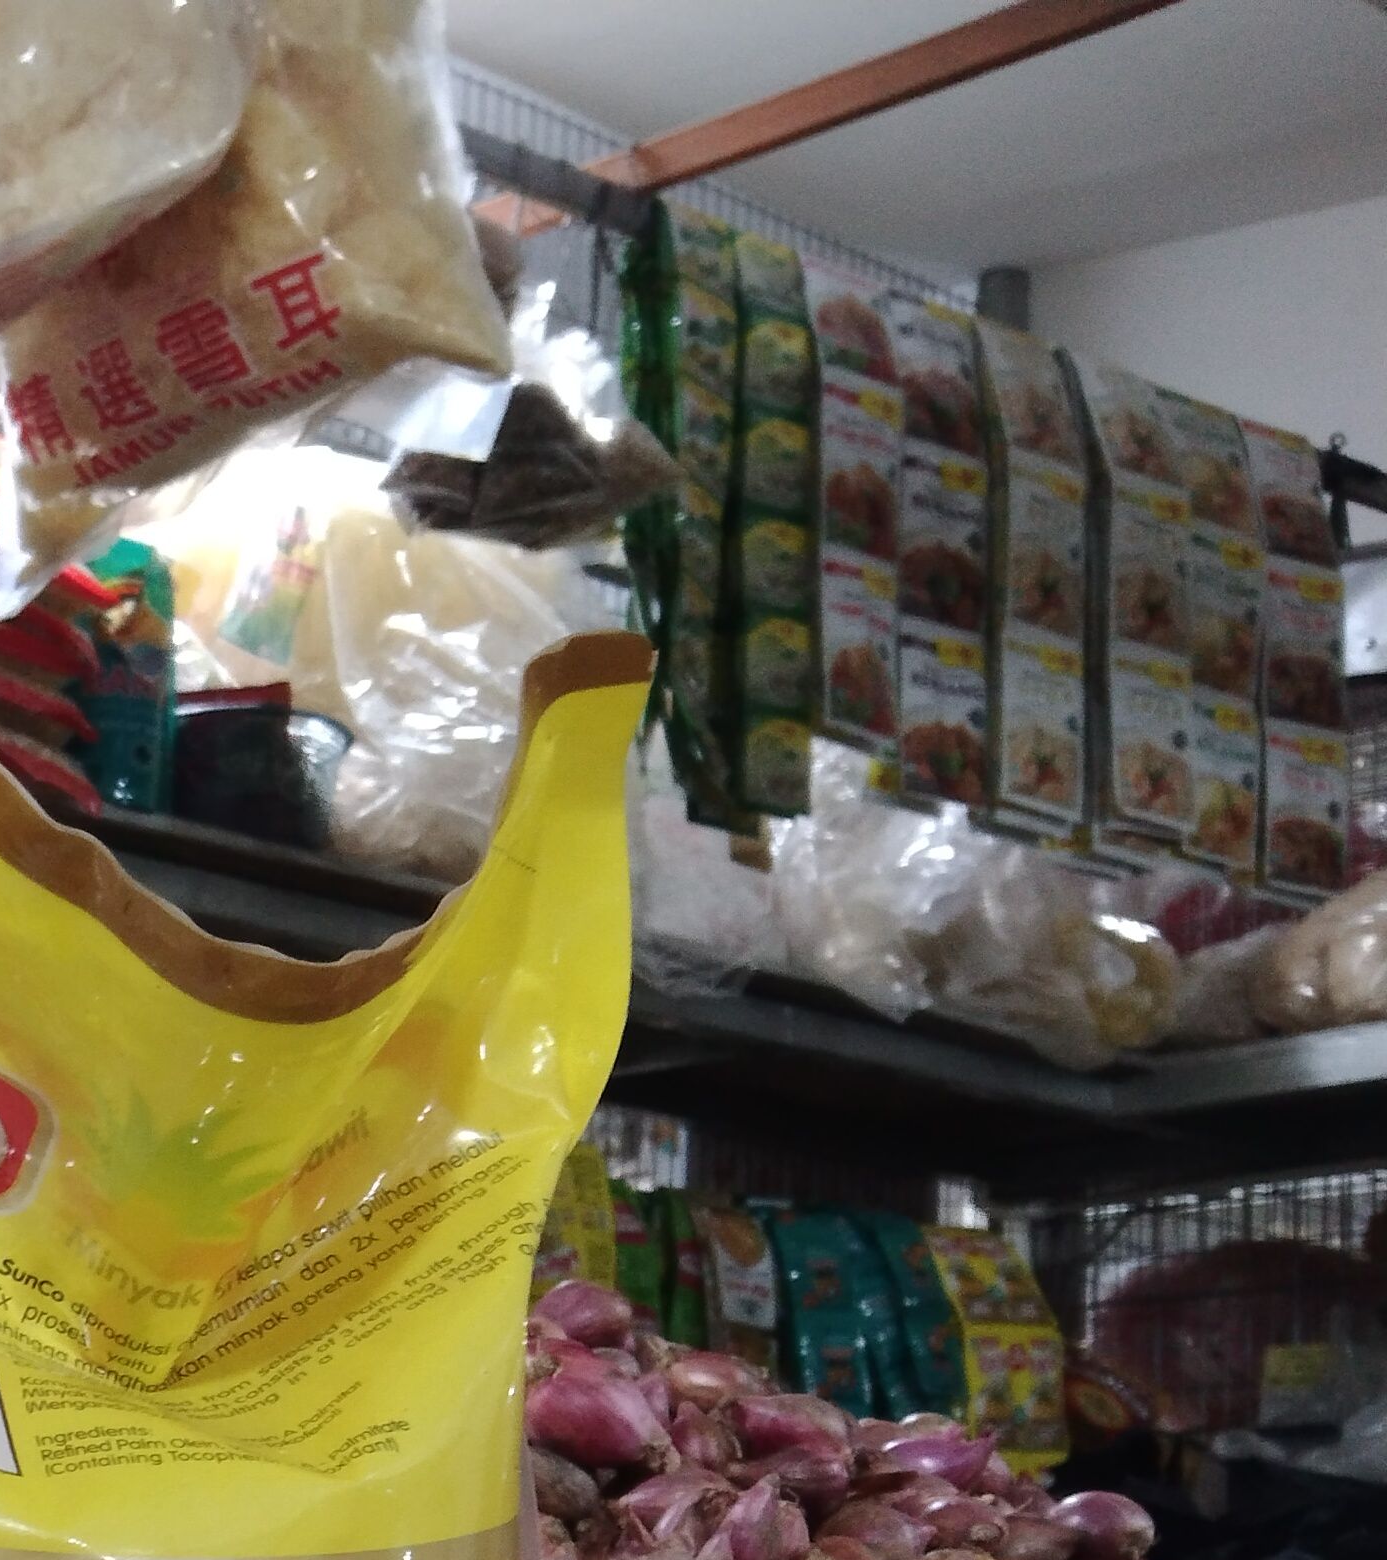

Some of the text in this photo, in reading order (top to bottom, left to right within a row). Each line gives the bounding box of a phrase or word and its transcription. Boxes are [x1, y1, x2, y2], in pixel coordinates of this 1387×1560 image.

[7, 253, 341, 464] 精選雪耳
[70, 1300, 175, 1357] diproduksi
[234, 1239, 297, 1283] kelapa
[301, 1209, 354, 1249] sawit
[439, 1235, 508, 1281] stages
[457, 1200, 538, 1253] through
[21, 1304, 91, 1352] proses
[106, 1350, 157, 1376] yaitu
[299, 1253, 343, 1284] dan
[215, 1311, 290, 1358] minyak
[291, 1270, 365, 1318] goreng
[366, 1234, 417, 1272] yang
[40, 1440, 114, 1463] Refined
[117, 1435, 167, 1450] Palm
